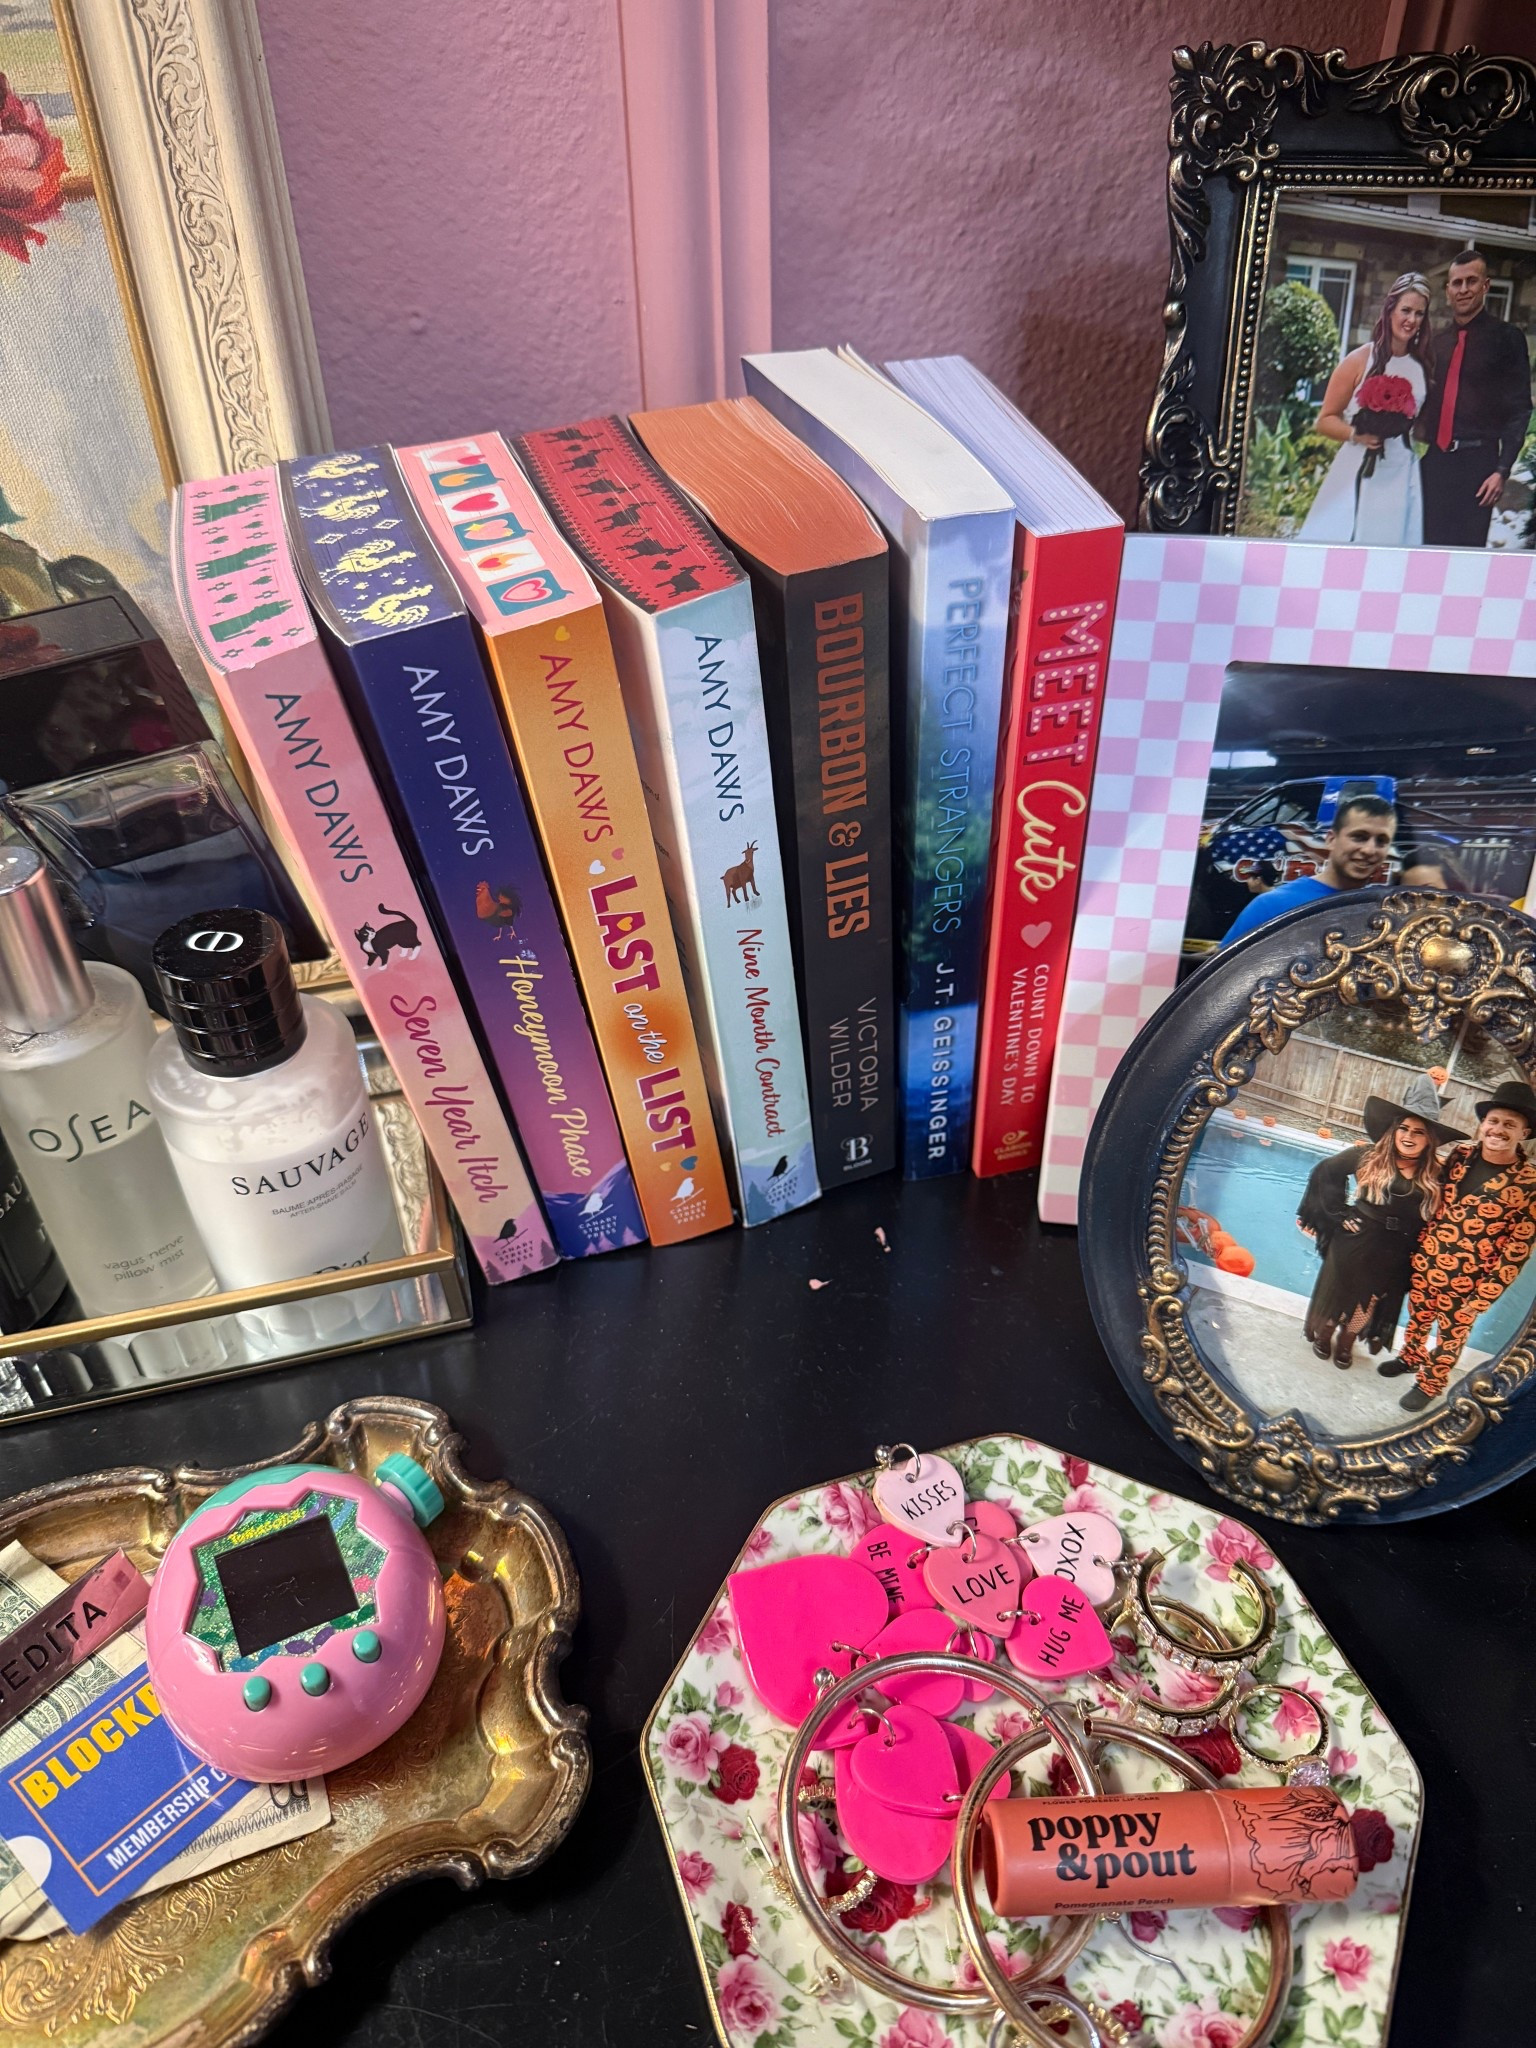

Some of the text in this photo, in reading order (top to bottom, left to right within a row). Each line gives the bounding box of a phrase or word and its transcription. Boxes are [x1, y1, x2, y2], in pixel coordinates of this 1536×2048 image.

[402, 666, 494, 856] AMY DAWS
[539, 655, 613, 843] AMY DAWS
[695, 635, 744, 822] AMY DAWS
[815, 591, 870, 939] BOURBON & LIES
[932, 578, 983, 933] PERFECT STRANGERS
[1014, 600, 1107, 903] MEET Cute
[265, 694, 374, 883] AMY DAWS
[588, 875, 696, 1153] LAST on the LIST
[737, 929, 785, 1138] Nine Month Contract
[1000, 967, 1029, 1106] VALENTINE'S DAY
[1020, 963, 1049, 1104] COUNT DOWN TO
[499, 955, 591, 1178] Honeymoon Phase
[829, 1017, 852, 1108] WILDER
[857, 997, 879, 1112] VICTORIA
[928, 962, 955, 1160] J.T. GEISSINGER
[28, 1099, 151, 1163] OSEA
[390, 994, 508, 1204] Seven Year Itch
[231, 1112, 370, 1196] SAUVAGE
[272, 1201, 305, 1216] BAUME
[578, 1215, 617, 1229] CANARY
[582, 1222, 617, 1235] STREET
[587, 1228, 616, 1240] PRESS
[670, 1199, 707, 1215] CANARY
[674, 1206, 706, 1220] STREET
[677, 1212, 705, 1224] PRESS
[103, 1235, 184, 1271] vagus nerve
[114, 1248, 185, 1282] pillow mist
[494, 1240, 533, 1257] CANARY
[499, 1246, 534, 1261] STREET
[504, 1253, 533, 1266] PRESS
[900, 1479, 957, 1521] KISSES
[866, 1540, 891, 1562] BE
[952, 1563, 1014, 1604] LOVE
[0, 1600, 108, 1699] EDITA
[1038, 1595, 1085, 1668] HUG ME
[105, 1775, 210, 1870] MEMBERSHIP
[1027, 1812, 1161, 1851] poppy
[1054, 1899, 1135, 1910] Pomegranate
[1138, 1897, 1174, 1906] Peach
